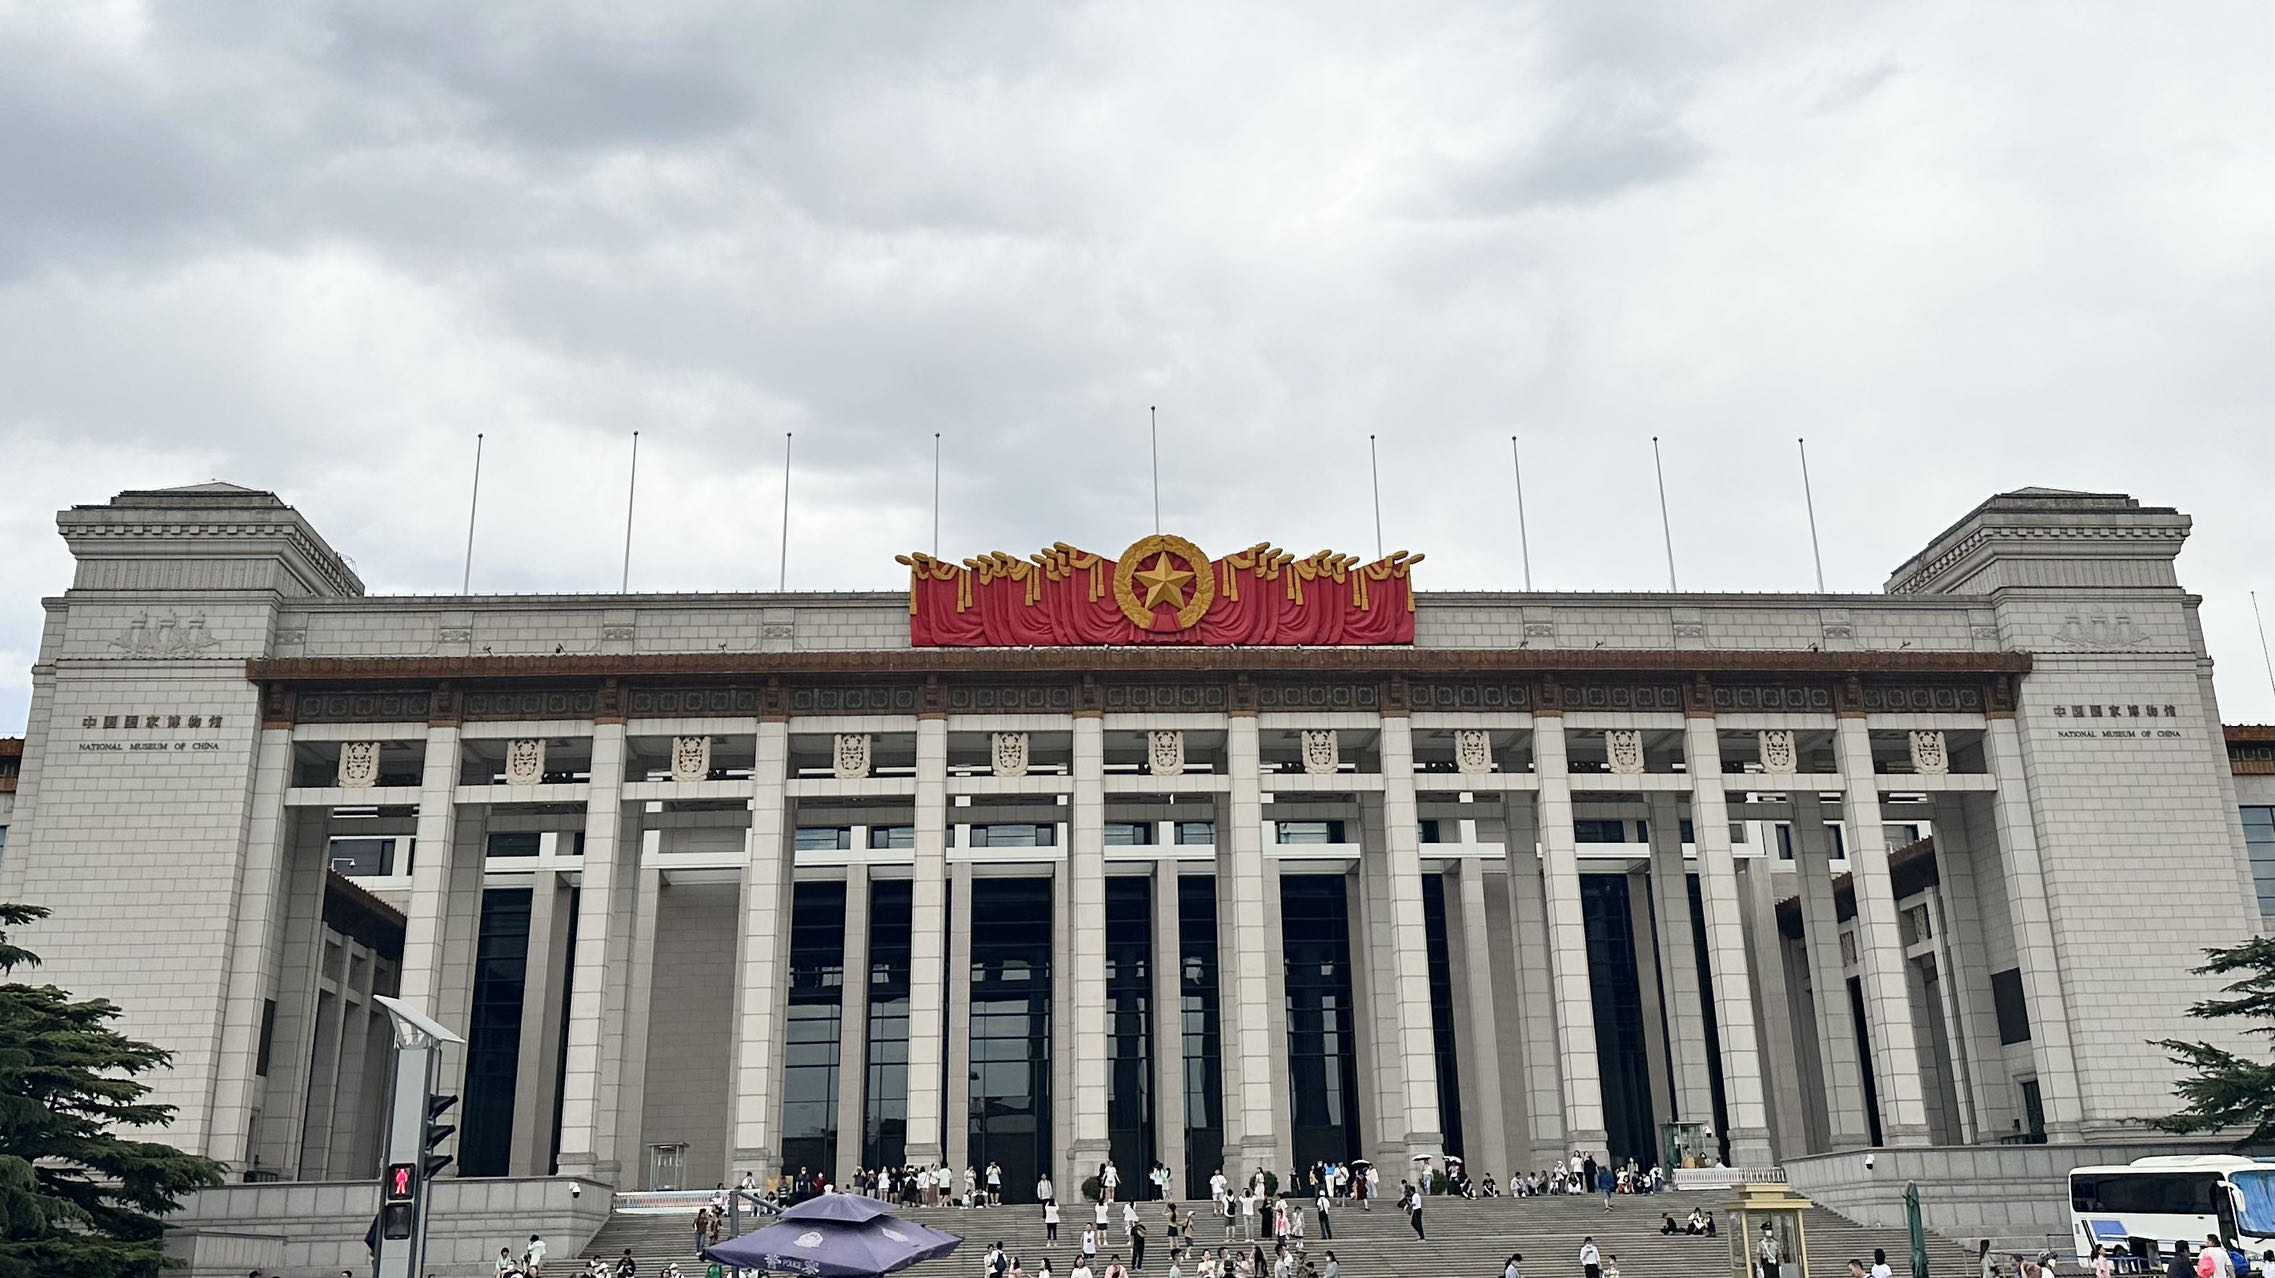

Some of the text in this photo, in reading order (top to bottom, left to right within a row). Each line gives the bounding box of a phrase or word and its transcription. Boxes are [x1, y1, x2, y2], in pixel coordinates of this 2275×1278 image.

[2053, 705, 2176, 717] 中国国家博物馆
[82, 715, 223, 729] 中国国家博物馆
[79, 742, 219, 751] NATIONAL MUSEUM OF CHINA
[782, 1258, 802, 1269] POLICE
